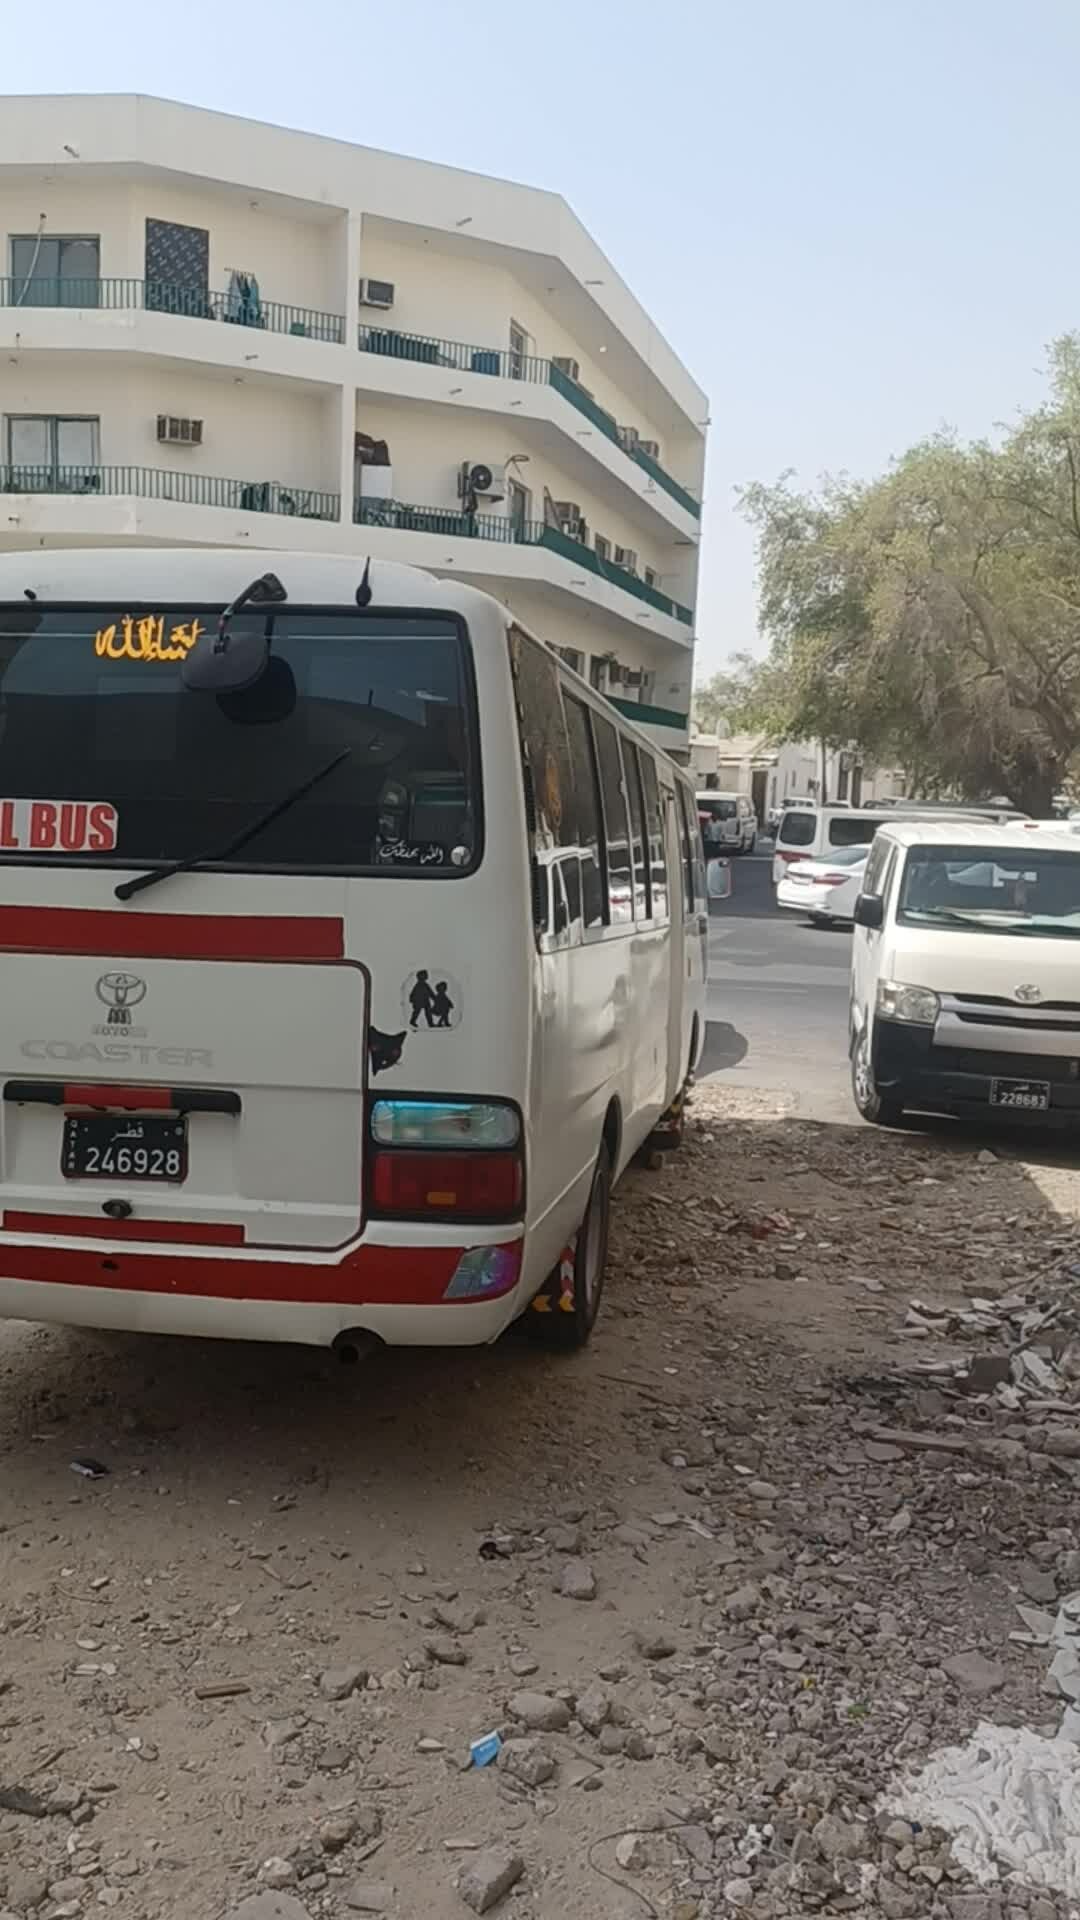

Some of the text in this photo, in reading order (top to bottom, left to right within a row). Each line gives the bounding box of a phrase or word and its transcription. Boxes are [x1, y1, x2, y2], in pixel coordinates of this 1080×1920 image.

[29, 802, 115, 851] BUS
[19, 1040, 214, 1068] COASTER
[1000, 1091, 1047, 1107] 228683
[110, 1121, 145, 1142] قطر
[85, 1146, 180, 1175] 246928
